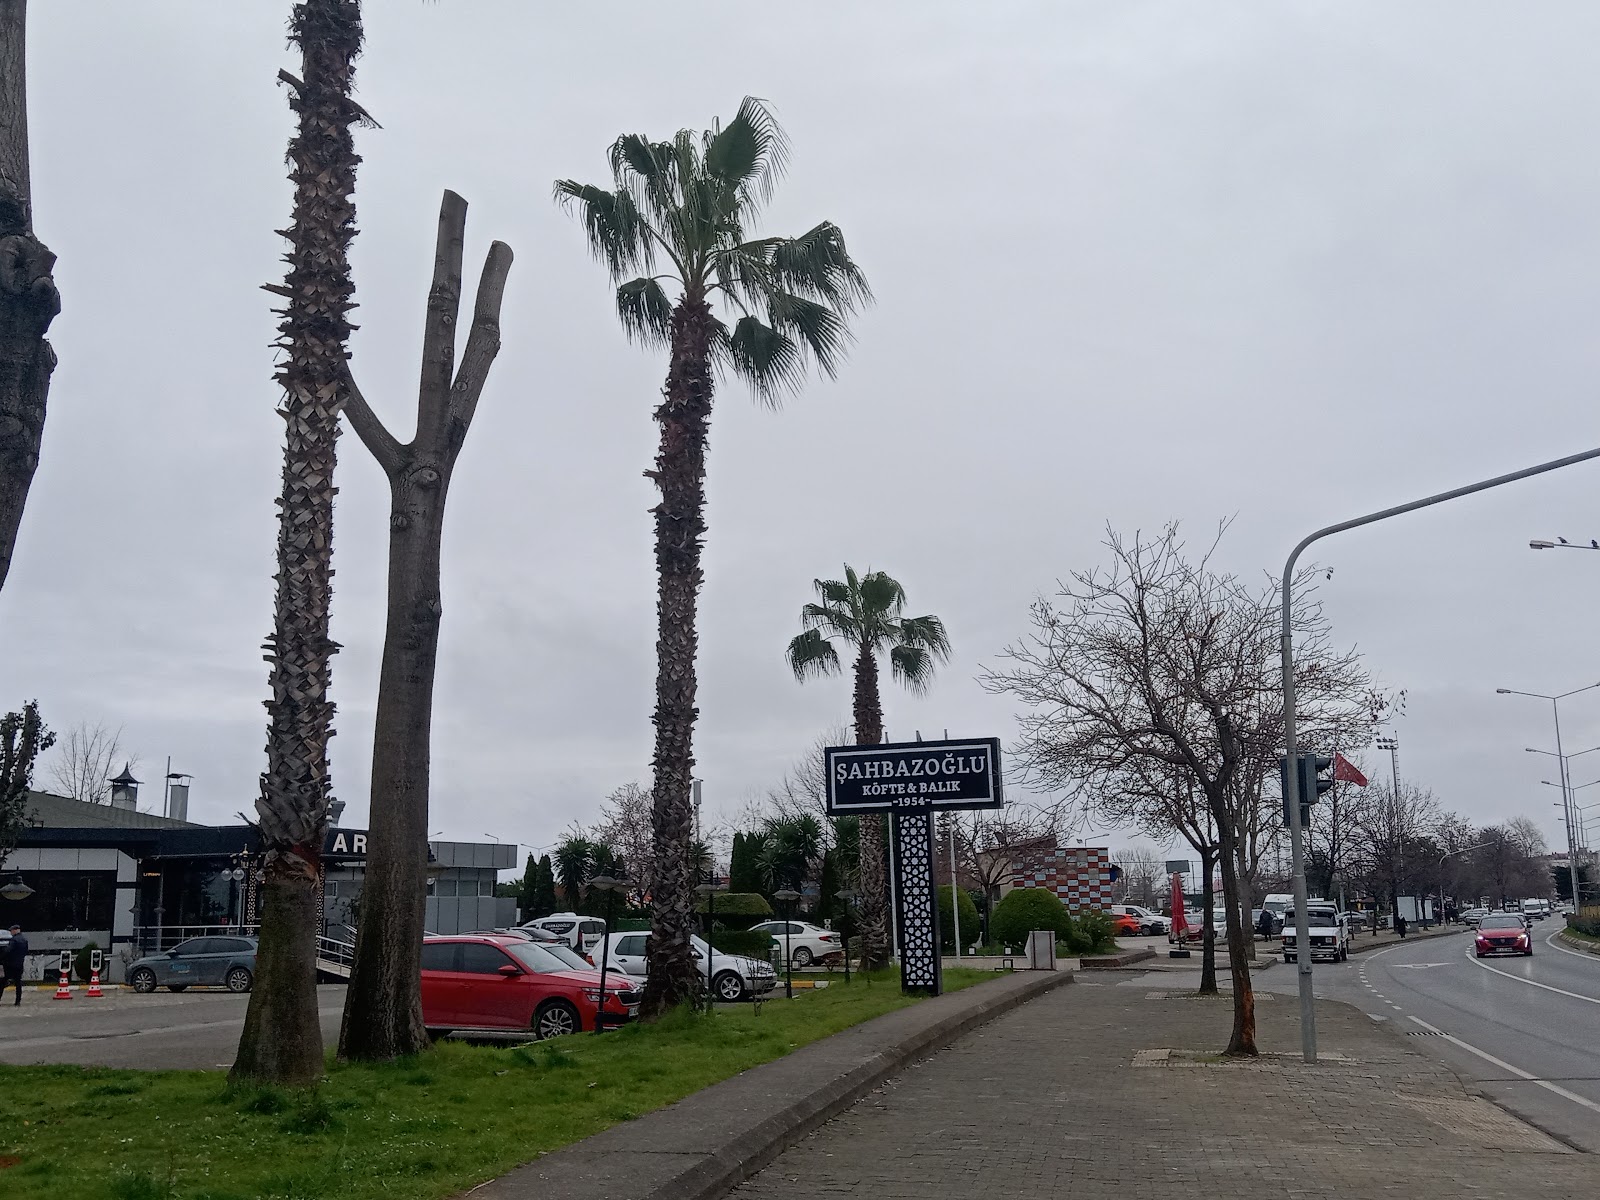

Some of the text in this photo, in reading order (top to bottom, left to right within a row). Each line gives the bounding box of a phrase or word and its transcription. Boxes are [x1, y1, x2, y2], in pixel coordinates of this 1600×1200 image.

[837, 753, 985, 783] ŞAHBAZOĞLU
[862, 781, 960, 795] KÖFTE & BALIK
